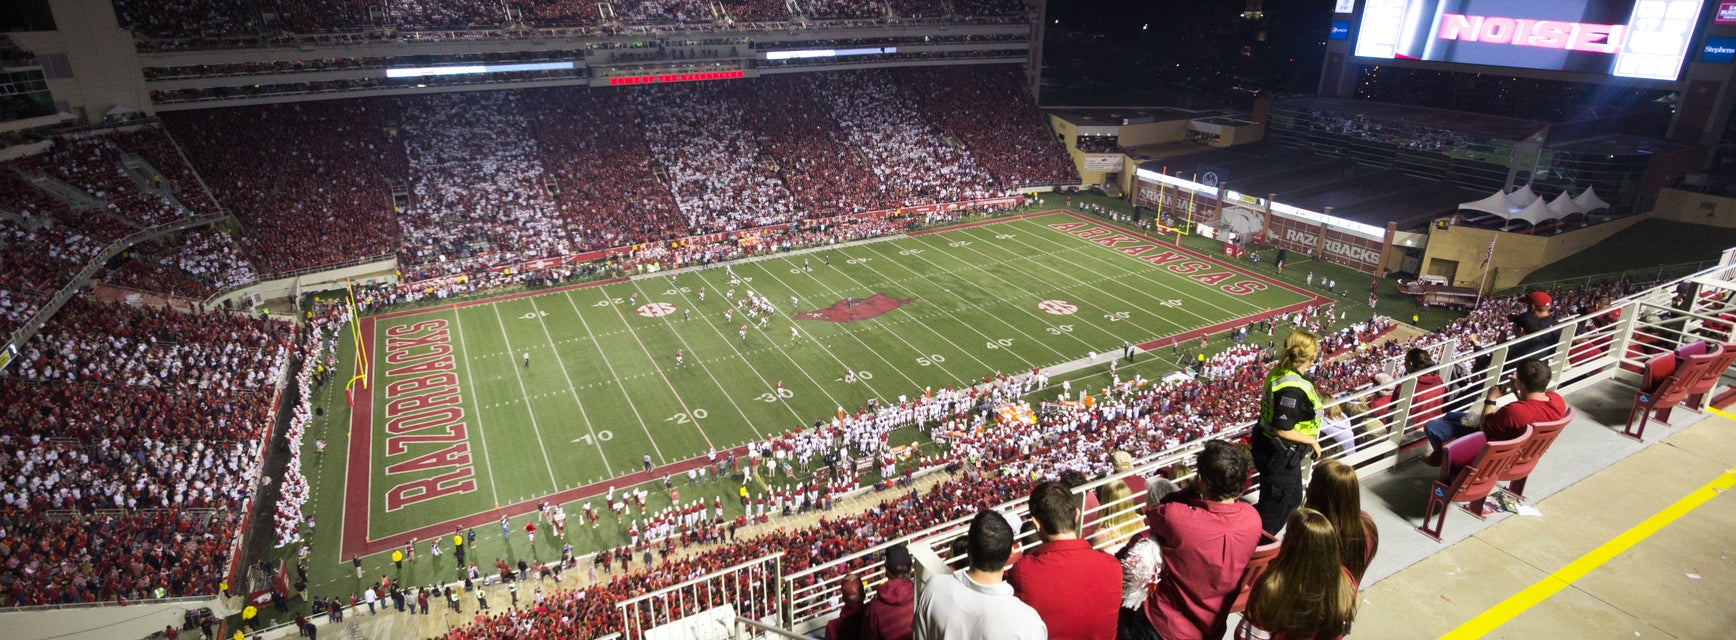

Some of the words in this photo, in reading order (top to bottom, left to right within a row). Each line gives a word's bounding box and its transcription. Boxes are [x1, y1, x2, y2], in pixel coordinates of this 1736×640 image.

[1704, 46, 1735, 54] Stephens
[610, 77, 640, 85] HOME
[657, 74, 678, 83] THE
[680, 70, 743, 81] RAZORBACKS
[1048, 222, 1268, 295] ARKANSAS
[636, 302, 677, 317] SEC
[1104, 311, 1129, 322] 20
[1046, 324, 1072, 335] 30
[986, 338, 1013, 350] 40
[915, 354, 945, 366] 50
[761, 388, 794, 403] 30
[385, 318, 478, 513] RAZORBACKS
[673, 408, 708, 424] 20
[582, 430, 614, 446] 10
